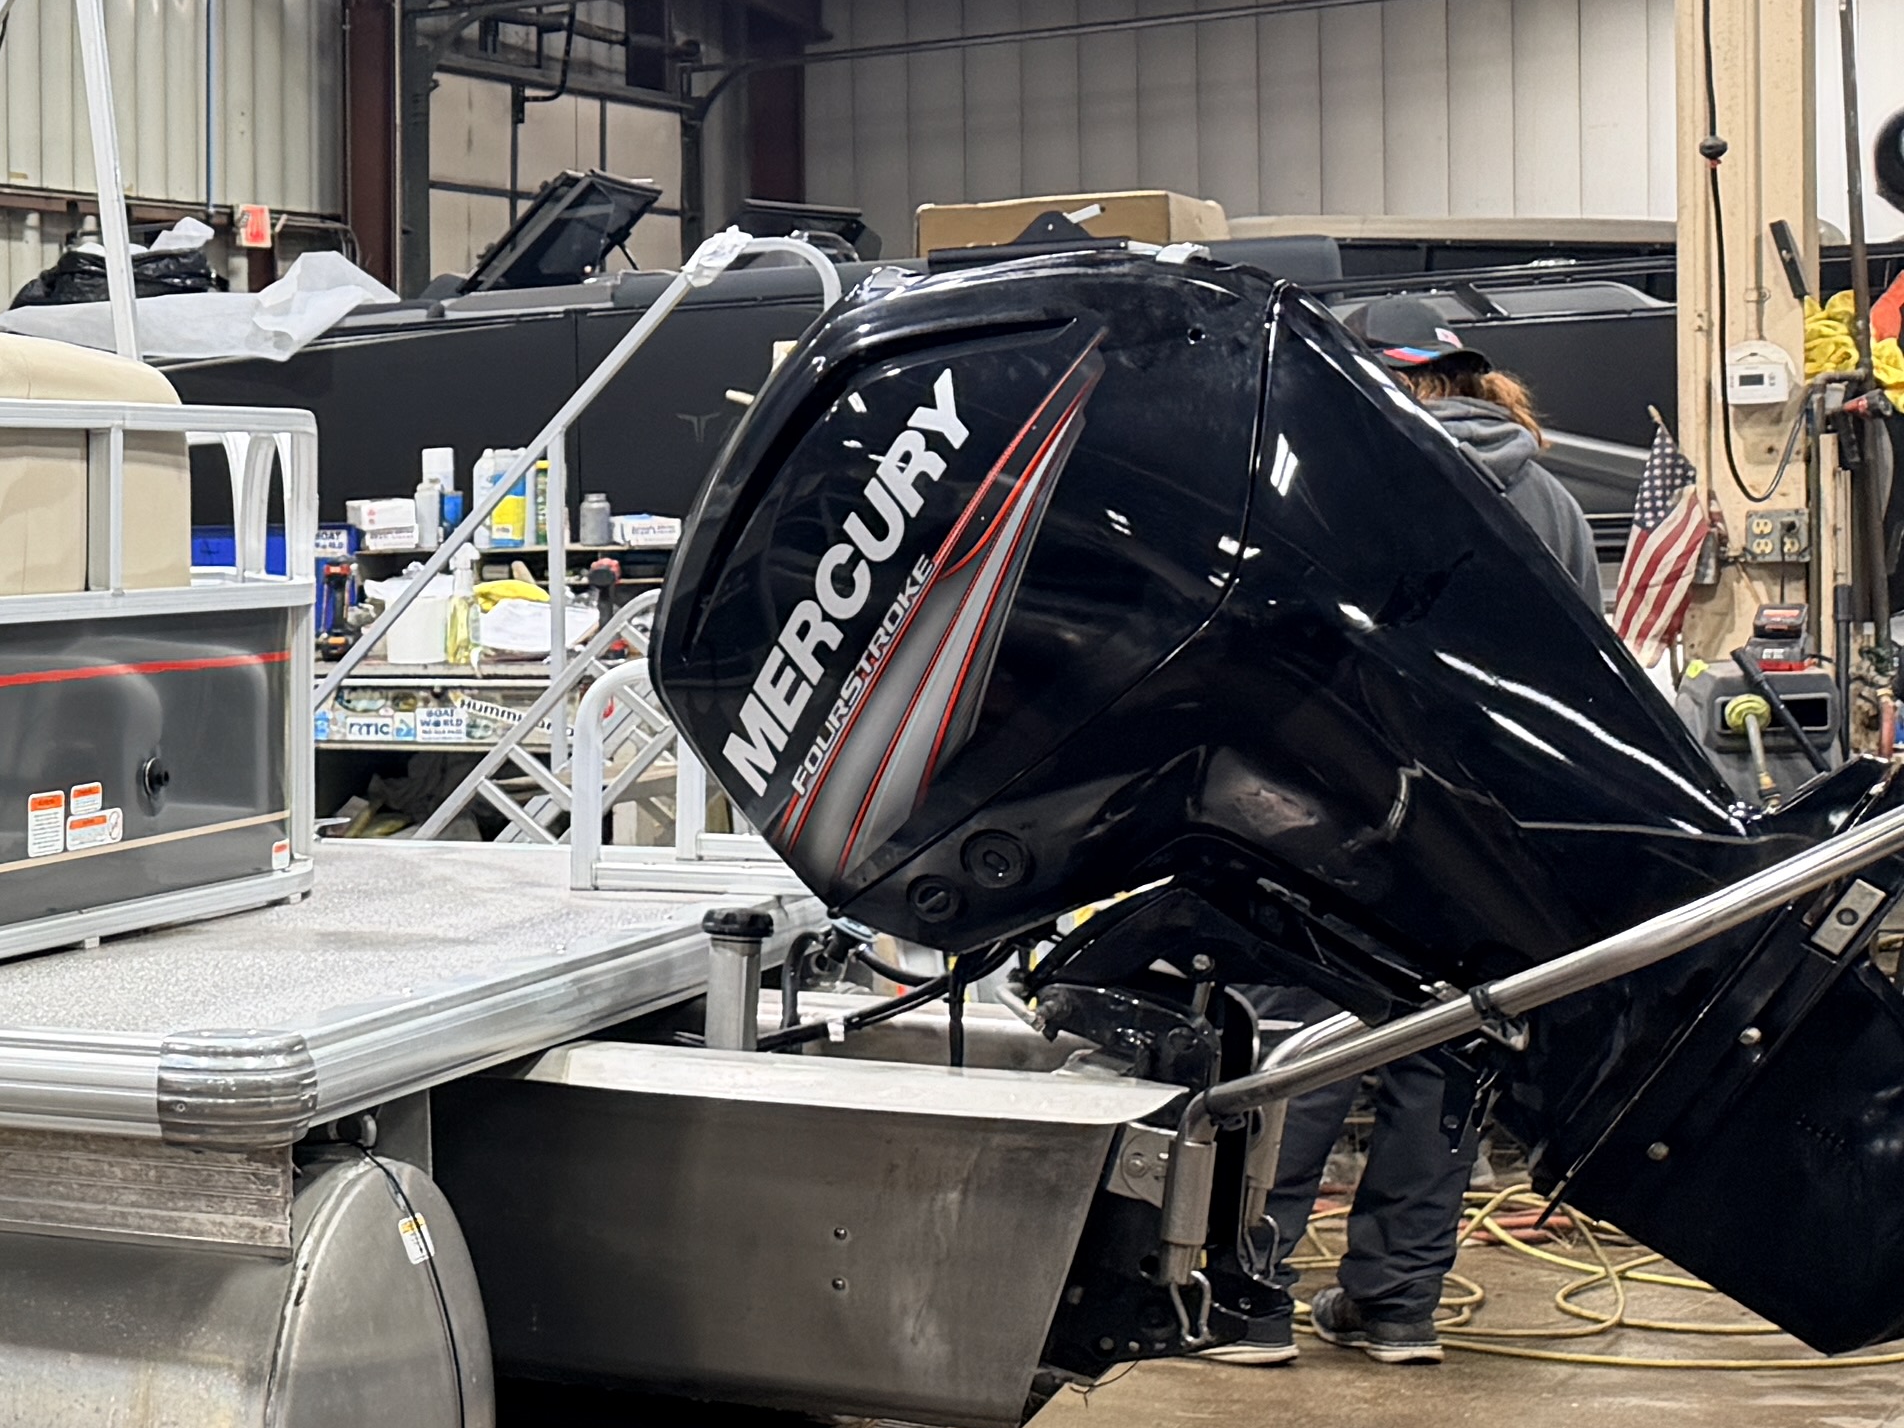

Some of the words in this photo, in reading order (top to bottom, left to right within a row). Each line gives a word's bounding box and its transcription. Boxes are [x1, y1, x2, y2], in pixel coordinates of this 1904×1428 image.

[722, 368, 969, 797] MERCURY
[792, 554, 936, 796] FOURSTROKE
[349, 722, 391, 736] RTIC
